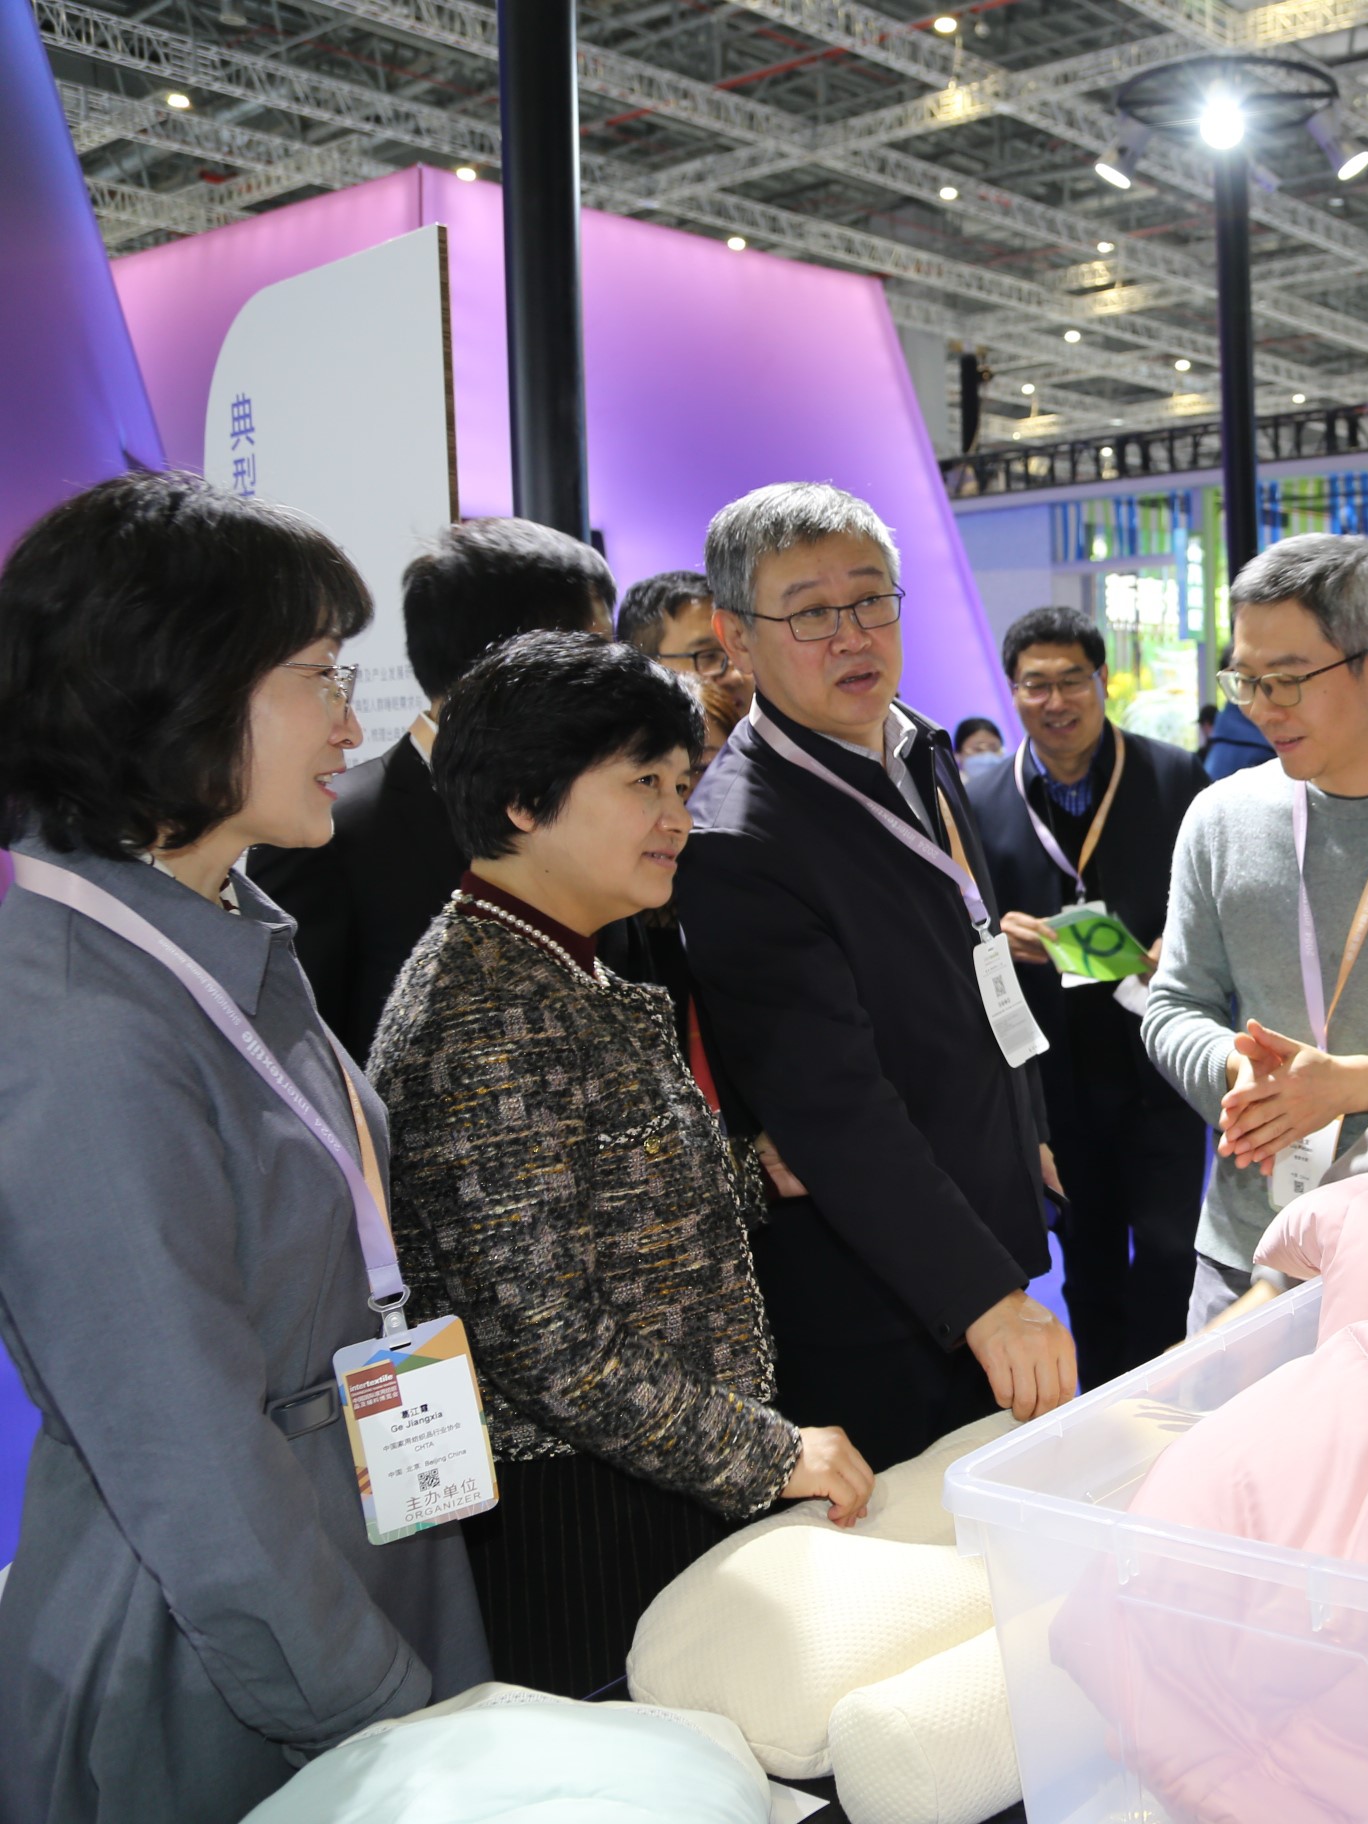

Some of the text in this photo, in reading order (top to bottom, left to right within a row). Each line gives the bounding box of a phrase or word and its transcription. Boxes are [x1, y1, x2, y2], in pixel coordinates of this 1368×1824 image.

[918, 842, 939, 859] 2024
[241, 1031, 310, 1115] intertextile
[315, 1118, 342, 1153] 2024
[349, 1372, 394, 1393] intertextile
[390, 1411, 443, 1433] Ge Jiangxia
[424, 1456, 447, 1467] Beijing
[447, 1449, 467, 1460] China
[405, 1491, 481, 1522] ORGANIZER
[406, 1478, 478, 1513] 主办单位
